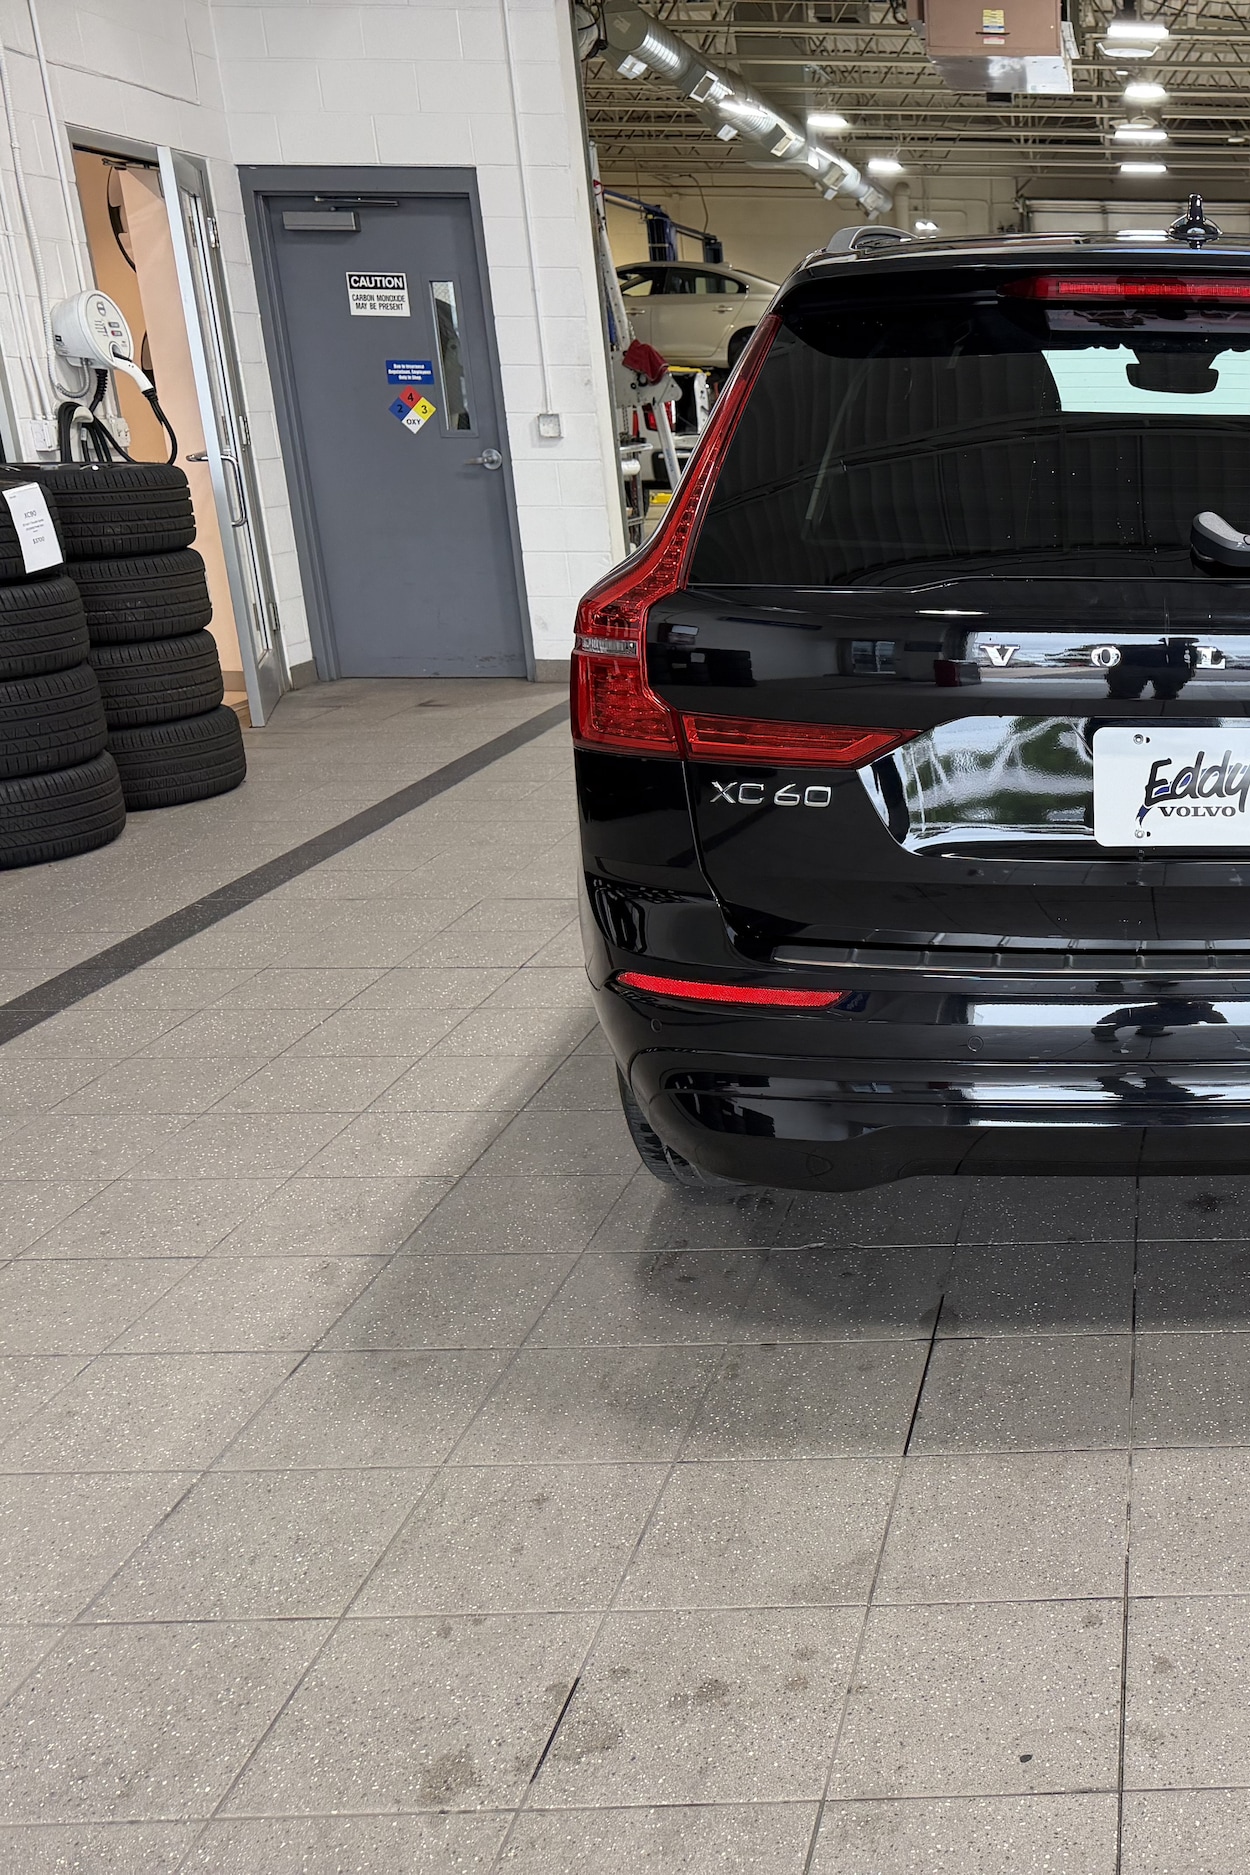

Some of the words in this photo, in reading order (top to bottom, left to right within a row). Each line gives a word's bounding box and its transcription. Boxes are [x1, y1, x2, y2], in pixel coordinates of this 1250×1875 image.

[350, 275, 404, 289] CAUTION
[352, 293, 375, 302] CARBON
[376, 294, 406, 303] MONOXIDE
[355, 302, 368, 310] MAY
[369, 302, 377, 311] BE
[378, 302, 403, 311] PRESENT
[407, 392, 414, 402] 4
[396, 404, 403, 413] 2
[421, 405, 428, 414] 3
[1157, 806, 1237, 818] VOLVO
